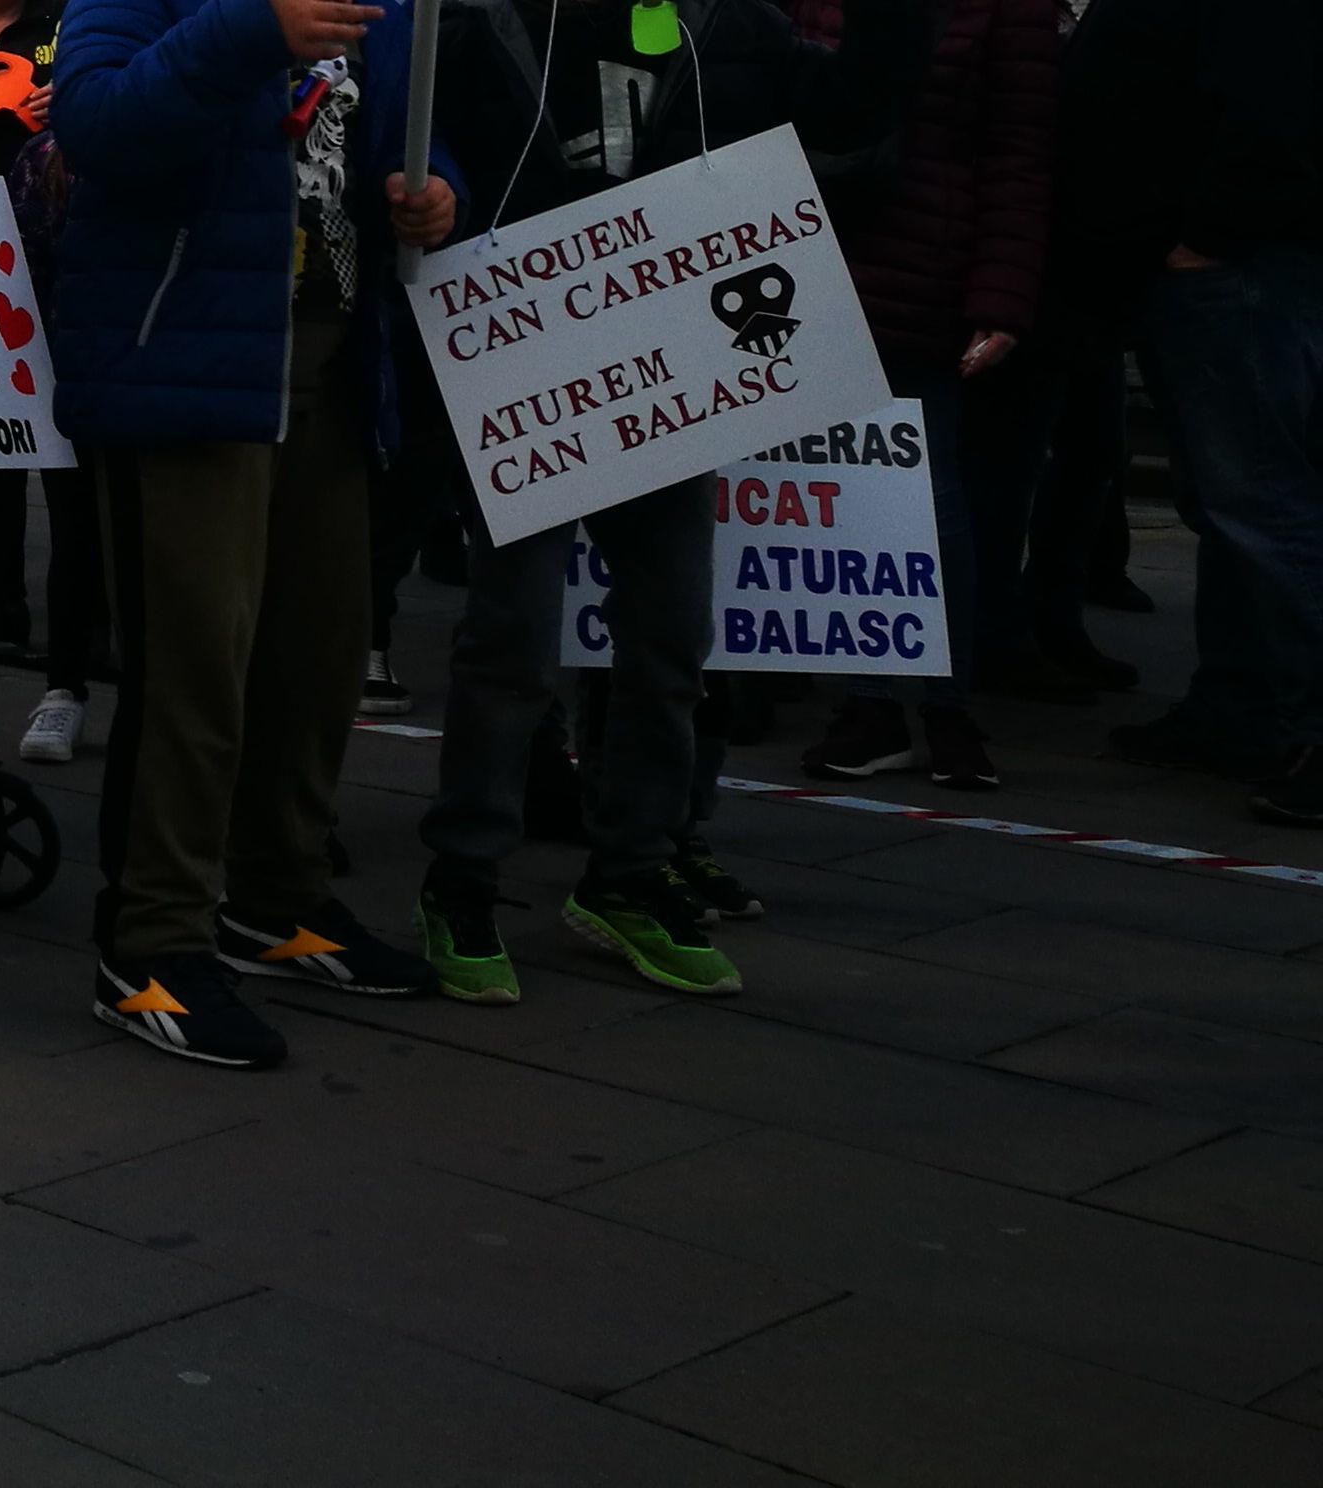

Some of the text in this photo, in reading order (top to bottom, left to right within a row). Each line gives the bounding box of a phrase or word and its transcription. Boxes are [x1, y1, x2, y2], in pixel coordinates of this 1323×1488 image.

[430, 208, 654, 318] TANQUEM
[447, 198, 823, 362] CAN CARRERAS
[480, 347, 675, 451] ATUREM
[490, 356, 800, 497] CAN BALASC
[736, 546, 938, 597] ATURAR
[724, 607, 925, 659] BALASC
